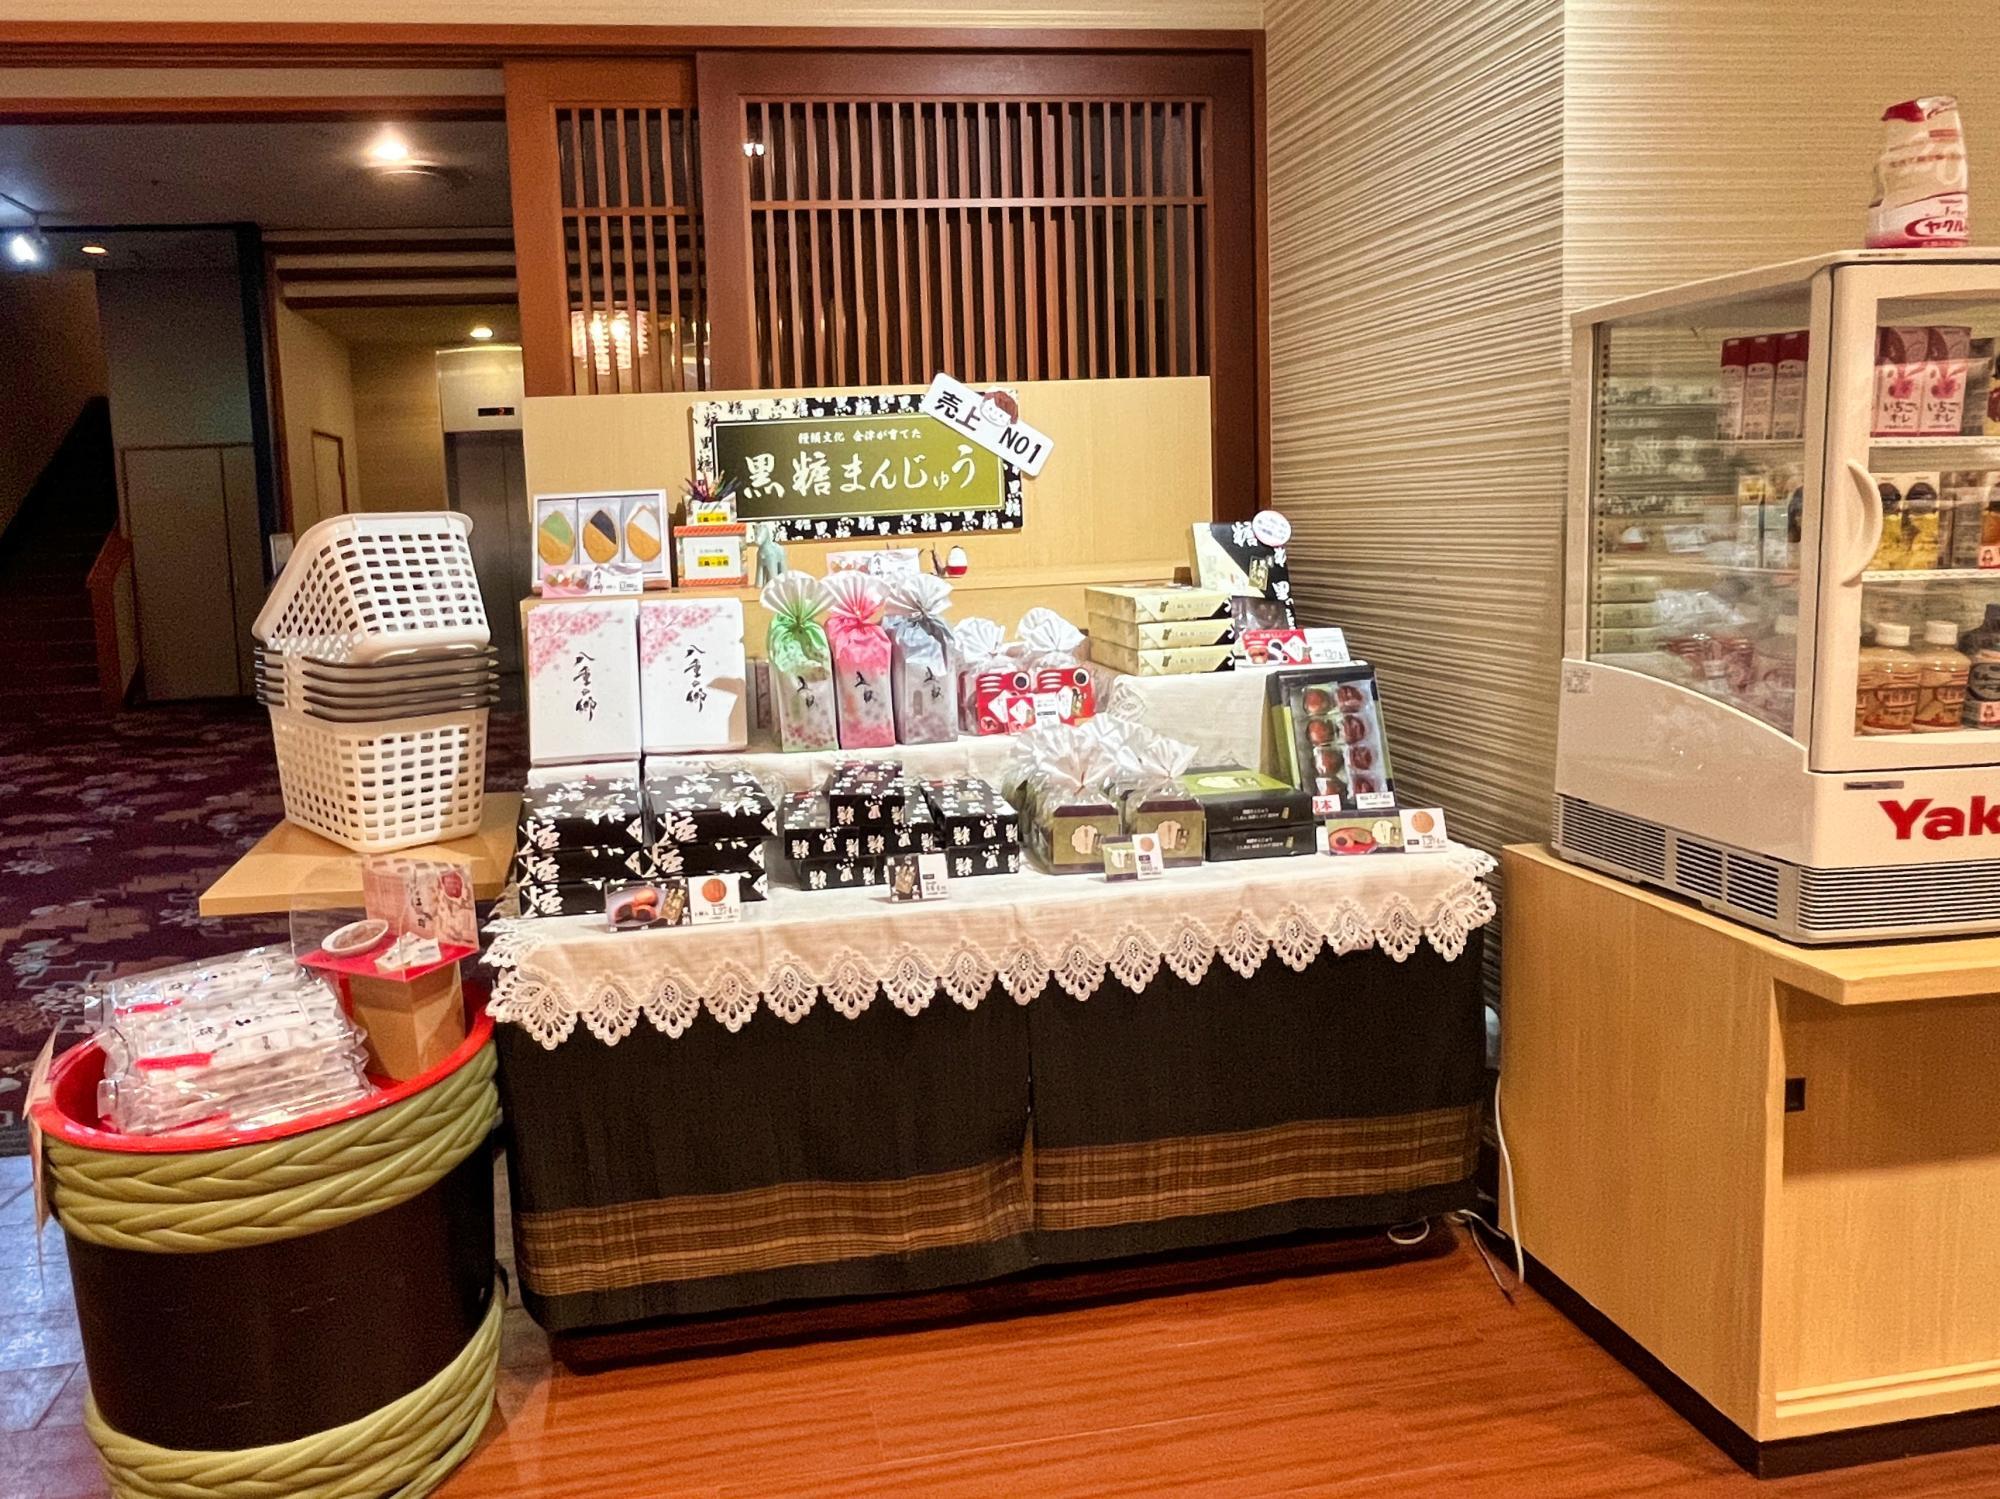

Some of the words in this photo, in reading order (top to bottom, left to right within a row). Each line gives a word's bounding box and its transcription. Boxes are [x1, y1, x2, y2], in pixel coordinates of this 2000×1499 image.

[934, 390, 981, 431] 売上
[1883, 401, 1918, 412] いちご
[1927, 401, 1960, 412] いちご
[1890, 413, 1911, 423] オレ
[1934, 414, 1953, 423] オレ
[852, 428, 922, 442] 会津が育てた
[999, 427, 1042, 463] NO1
[743, 444, 977, 500] 黒糖まんじゅう
